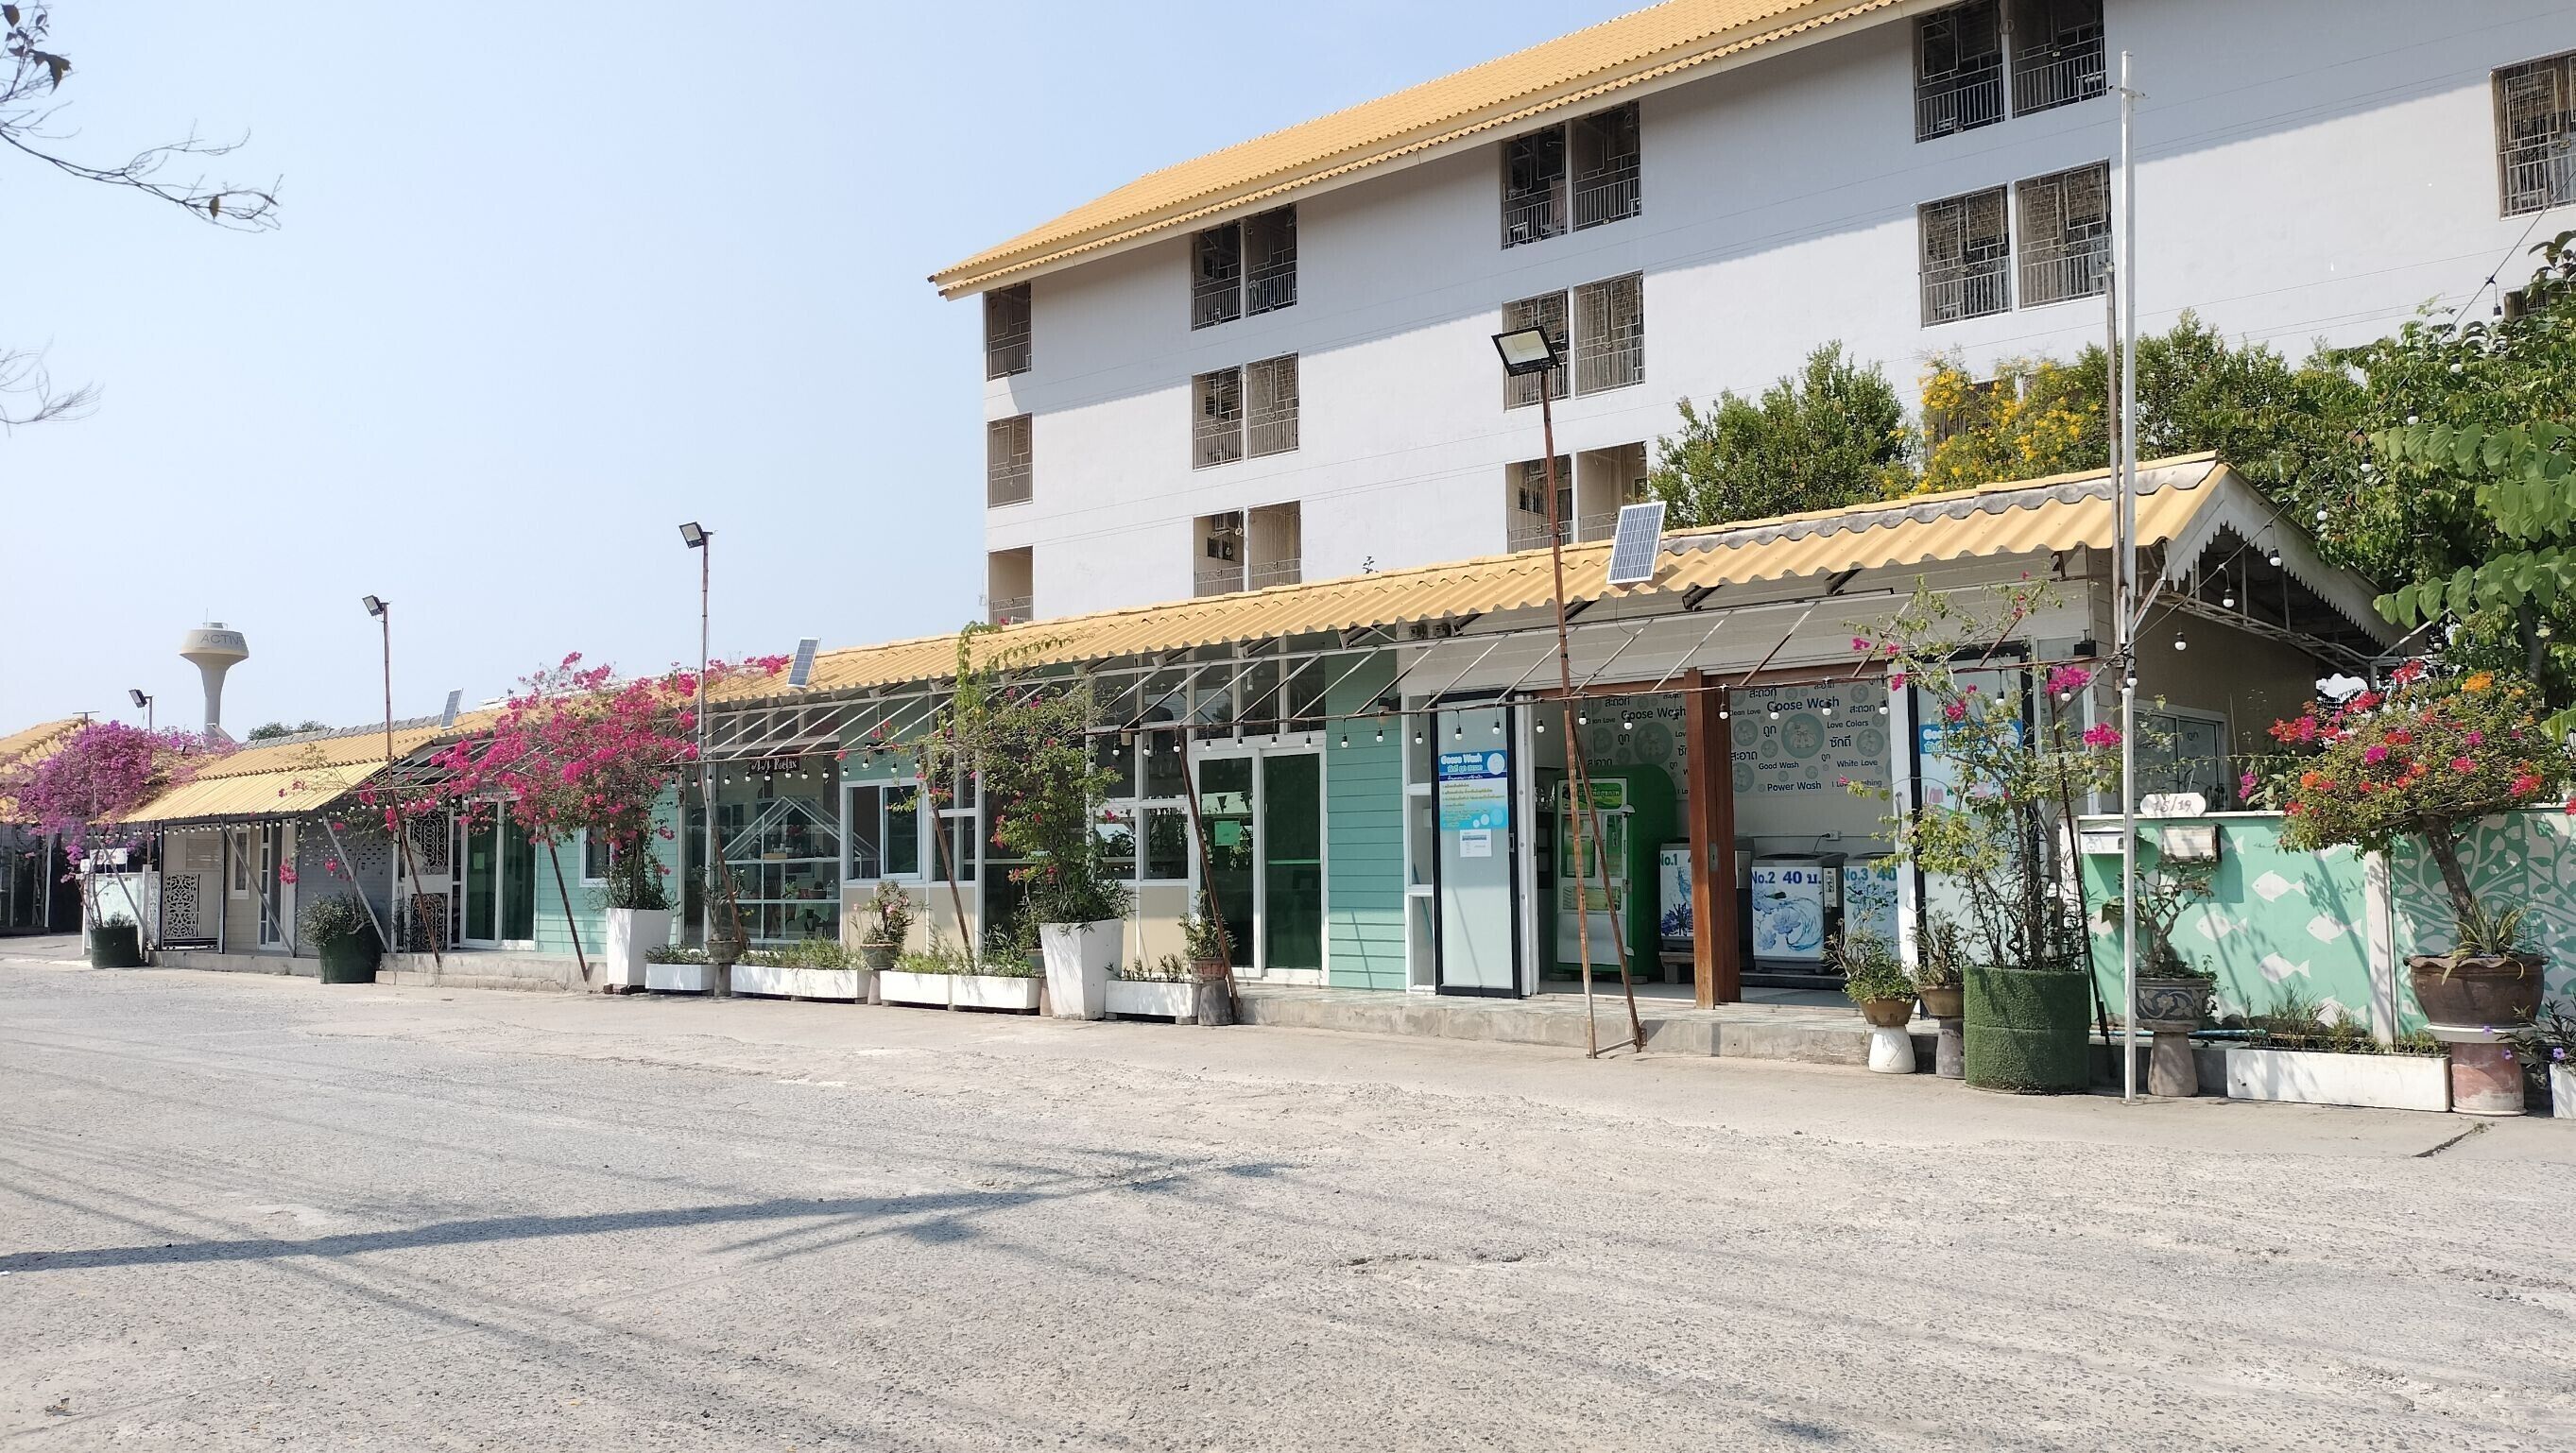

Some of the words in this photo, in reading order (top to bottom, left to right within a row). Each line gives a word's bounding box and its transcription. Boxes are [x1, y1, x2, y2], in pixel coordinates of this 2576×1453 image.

[1767, 700, 1803, 712] Goose
[1807, 696, 1840, 709] Wash
[1622, 709, 1654, 720] Goose
[1763, 726, 1777, 738] ถูก
[1759, 761, 1777, 770] Good
[1779, 761, 1799, 769] Wash
[1767, 783, 1795, 792] Power
[1797, 780, 1822, 790] Wash
[2154, 795, 2192, 812] 15/19
[1751, 871, 1776, 884] No.2
[1782, 870, 1802, 884] 40
[1843, 867, 1869, 881] No.3
